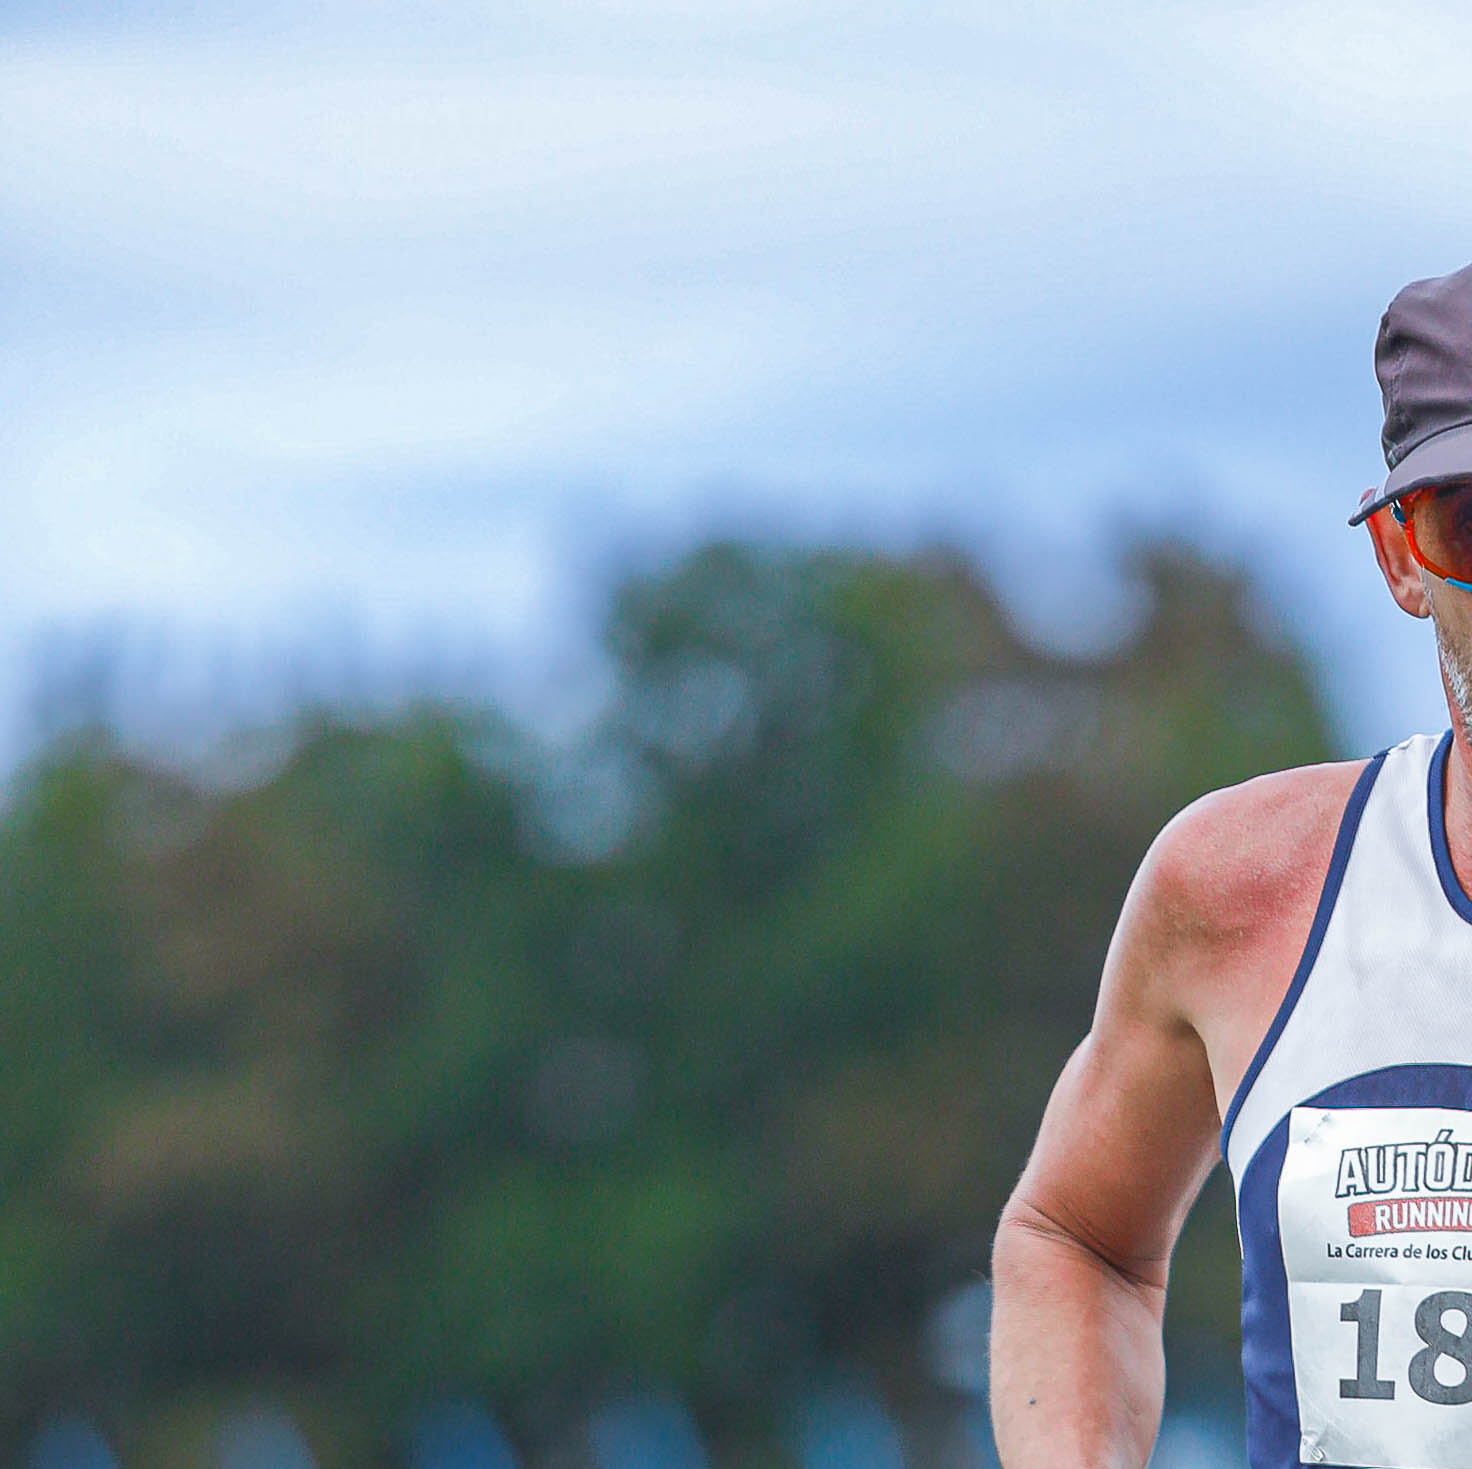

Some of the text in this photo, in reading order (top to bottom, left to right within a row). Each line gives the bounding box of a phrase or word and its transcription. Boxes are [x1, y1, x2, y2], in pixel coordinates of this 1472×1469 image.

[1327, 1243, 1342, 1258] La
[1346, 1243, 1398, 1258] Carrera
[1402, 1244, 1422, 1258] de
[1426, 1244, 1448, 1259] los
